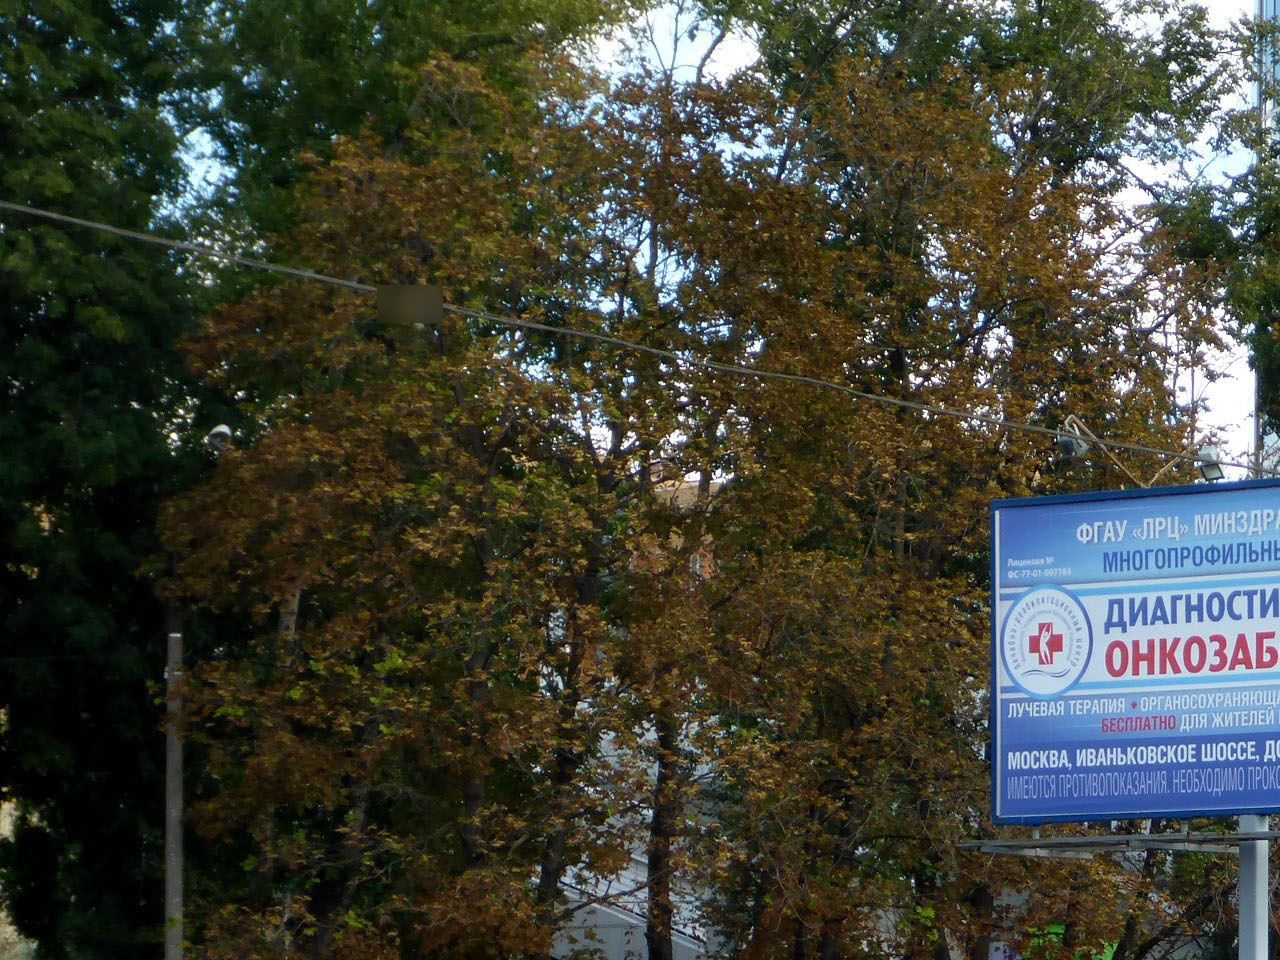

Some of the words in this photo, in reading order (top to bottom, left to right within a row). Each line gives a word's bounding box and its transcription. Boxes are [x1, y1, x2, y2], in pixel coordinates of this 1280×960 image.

[1076, 519, 1128, 544] ФГАУ
[1132, 516, 1189, 541] «ЛРЦ»
[1007, 557, 1045, 569] Лицензия
[1008, 700, 1065, 719] ЛУЧЕВАЯ
[1069, 698, 1125, 715] ТЕРАПИЯ
[1101, 714, 1176, 734] БЕСПЛАТНО
[1179, 712, 1208, 733] ДЛЯ
[1211, 706, 1275, 729] ЖИТЕЛЕЙ
[1007, 750, 1073, 771] МОСКВА,
[1076, 743, 1197, 767] ИВАНЬКОВСКОЕ
[1201, 740, 1261, 763] ШОССЕ,
[1007, 773, 1057, 800] ИМЕЮТСЯ
[1058, 769, 1170, 799] ПРОТИВОПОКАЗАНИЯ.
[1173, 766, 1245, 796] НЕОБХОДИМО
